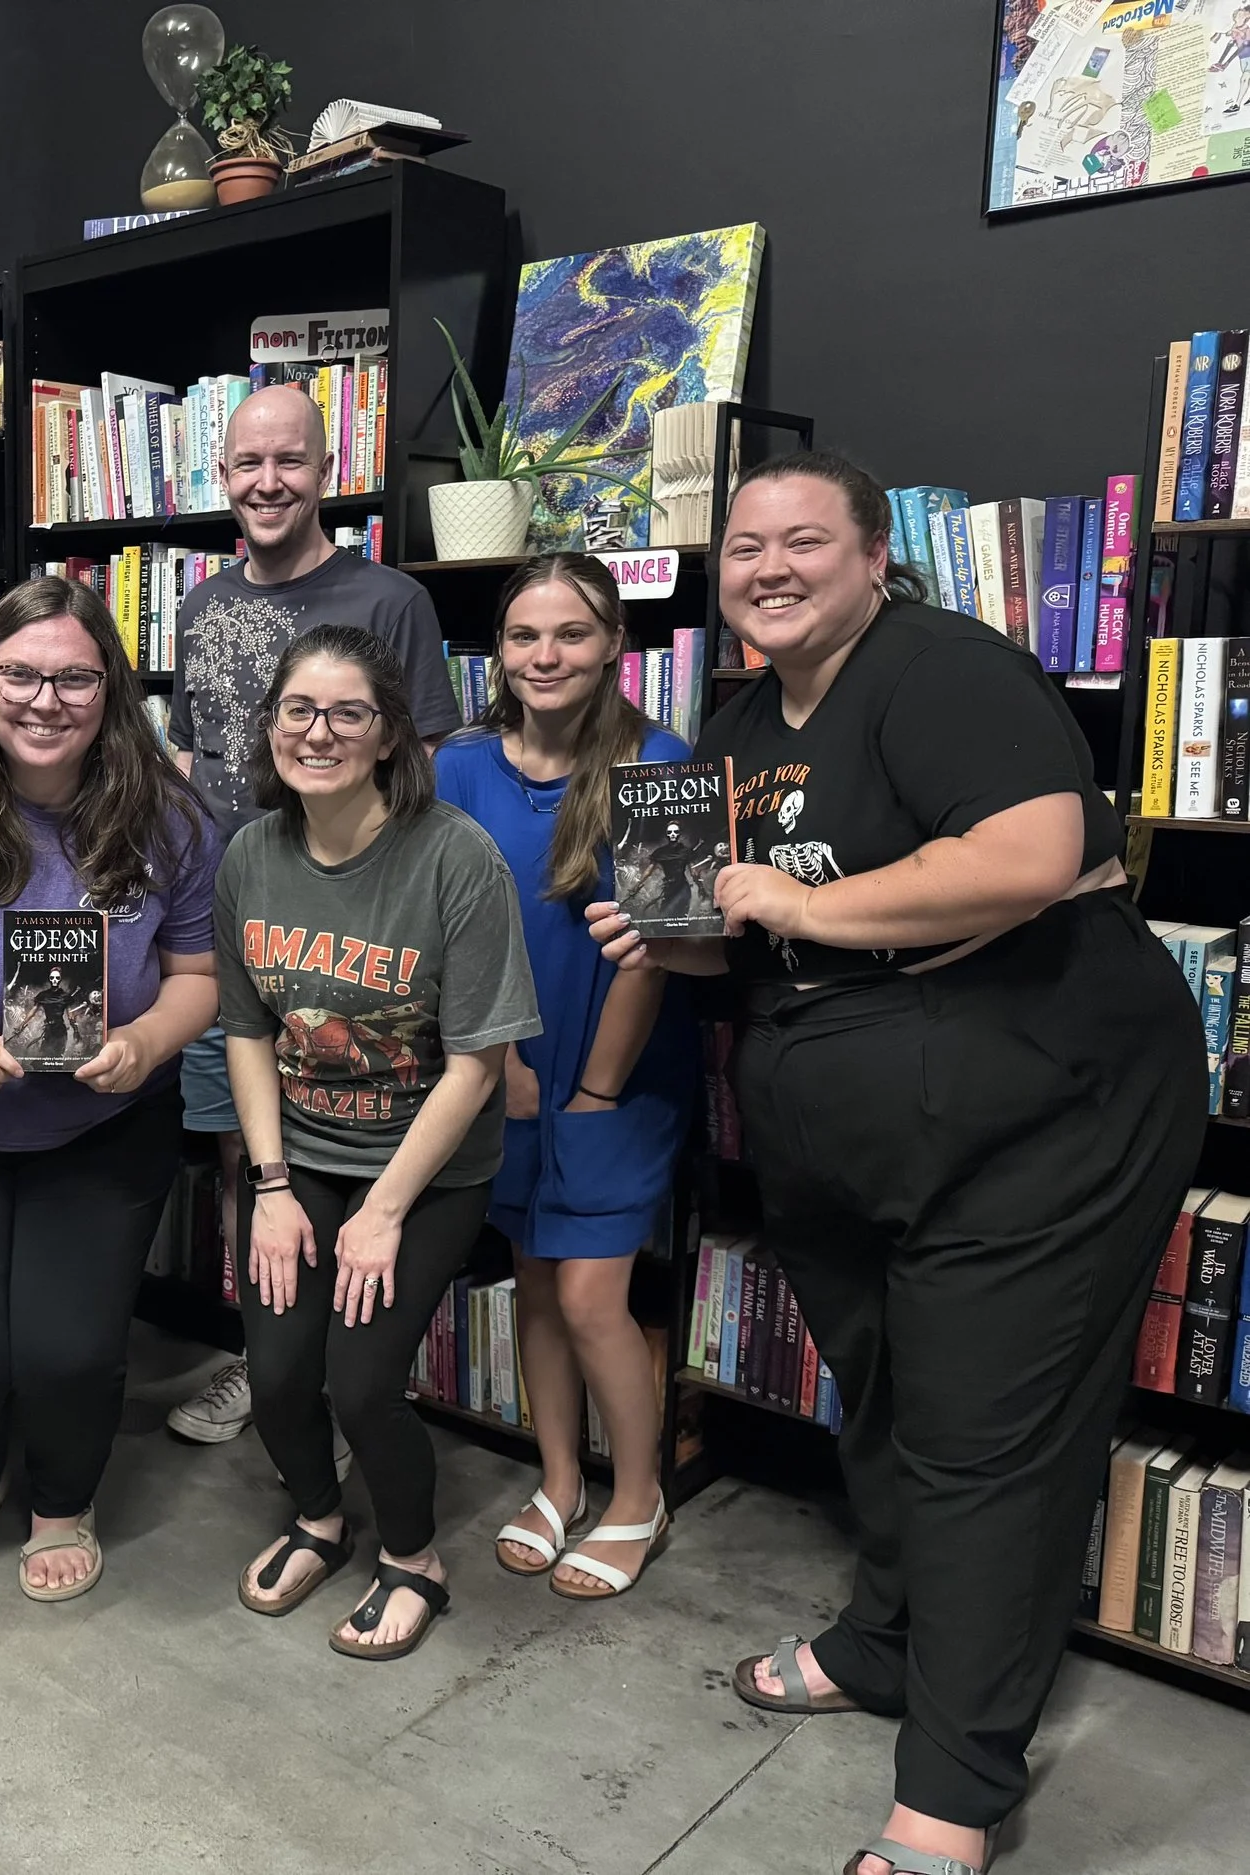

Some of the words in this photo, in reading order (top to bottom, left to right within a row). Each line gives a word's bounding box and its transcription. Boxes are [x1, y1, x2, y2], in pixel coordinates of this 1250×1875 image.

[1102, 0, 1174, 33] MetroCard
[252, 320, 391, 357] non-FICTION
[1188, 384, 1211, 412] NORA
[1218, 383, 1240, 412] NORA
[217, 399, 225, 443] Atomic
[356, 409, 366, 435] QUIT
[1185, 413, 1208, 456] ROBERTS
[1213, 413, 1236, 455] ROBERTS
[356, 437, 366, 476] VAPING
[1105, 499, 1120, 551] Moment
[1117, 511, 1131, 537] One
[123, 552, 132, 582] MIDNIGHT
[141, 564, 149, 584] THE
[607, 557, 672, 585] ANCE
[122, 589, 131, 623] CHERNOBYL
[140, 587, 149, 617] BLACK
[139, 619, 147, 651] COUNT
[1053, 611, 1061, 628] ANA
[1097, 603, 1111, 647] HUNTER
[1111, 607, 1125, 641] BECKY
[1050, 629, 1060, 655] HUANG
[1193, 642, 1208, 700] NICHOLAS
[1154, 660, 1170, 726] NICHOLAS
[1191, 701, 1205, 738] SPARKS
[1151, 728, 1166, 771] SPARKS
[1224, 738, 1236, 779] SPARKS
[1234, 731, 1249, 786] NICHOLAS
[622, 766, 675, 779] TAMSYN
[680, 762, 714, 774] MUIR
[734, 770, 769, 799] GOT
[773, 763, 811, 786] YOUR
[1190, 761, 1201, 779] SEE
[1188, 781, 1200, 797] ME
[631, 806, 660, 818] THE
[663, 802, 711, 816] NINTH
[15, 917, 60, 925] TAMSYN
[64, 917, 93, 925] MUIR
[21, 953, 45, 962] THE
[48, 953, 88, 962] NINTH
[243, 919, 421, 997] AMAZE!
[1190, 950, 1199, 964] SEE
[257, 974, 286, 994] AZE!
[1188, 965, 1197, 985] YOU
[1238, 995, 1250, 1010] THE
[1231, 1011, 1250, 1056] FALLING
[282, 1075, 394, 1120] AMAZE!
[756, 1267, 768, 1296] SABLE
[1200, 1248, 1217, 1285] WARD
[754, 1297, 766, 1321] PEAK
[1193, 1329, 1205, 1347] AT
[1188, 1346, 1203, 1379] LAST
[1200, 1335, 1218, 1376] LOVER
[1215, 1493, 1228, 1511] The
[1173, 1527, 1189, 1562] FREE
[1207, 1507, 1227, 1578] MIDWIFE
[1173, 1563, 1187, 1580] TO
[1169, 1581, 1187, 1630] CHOOSE
